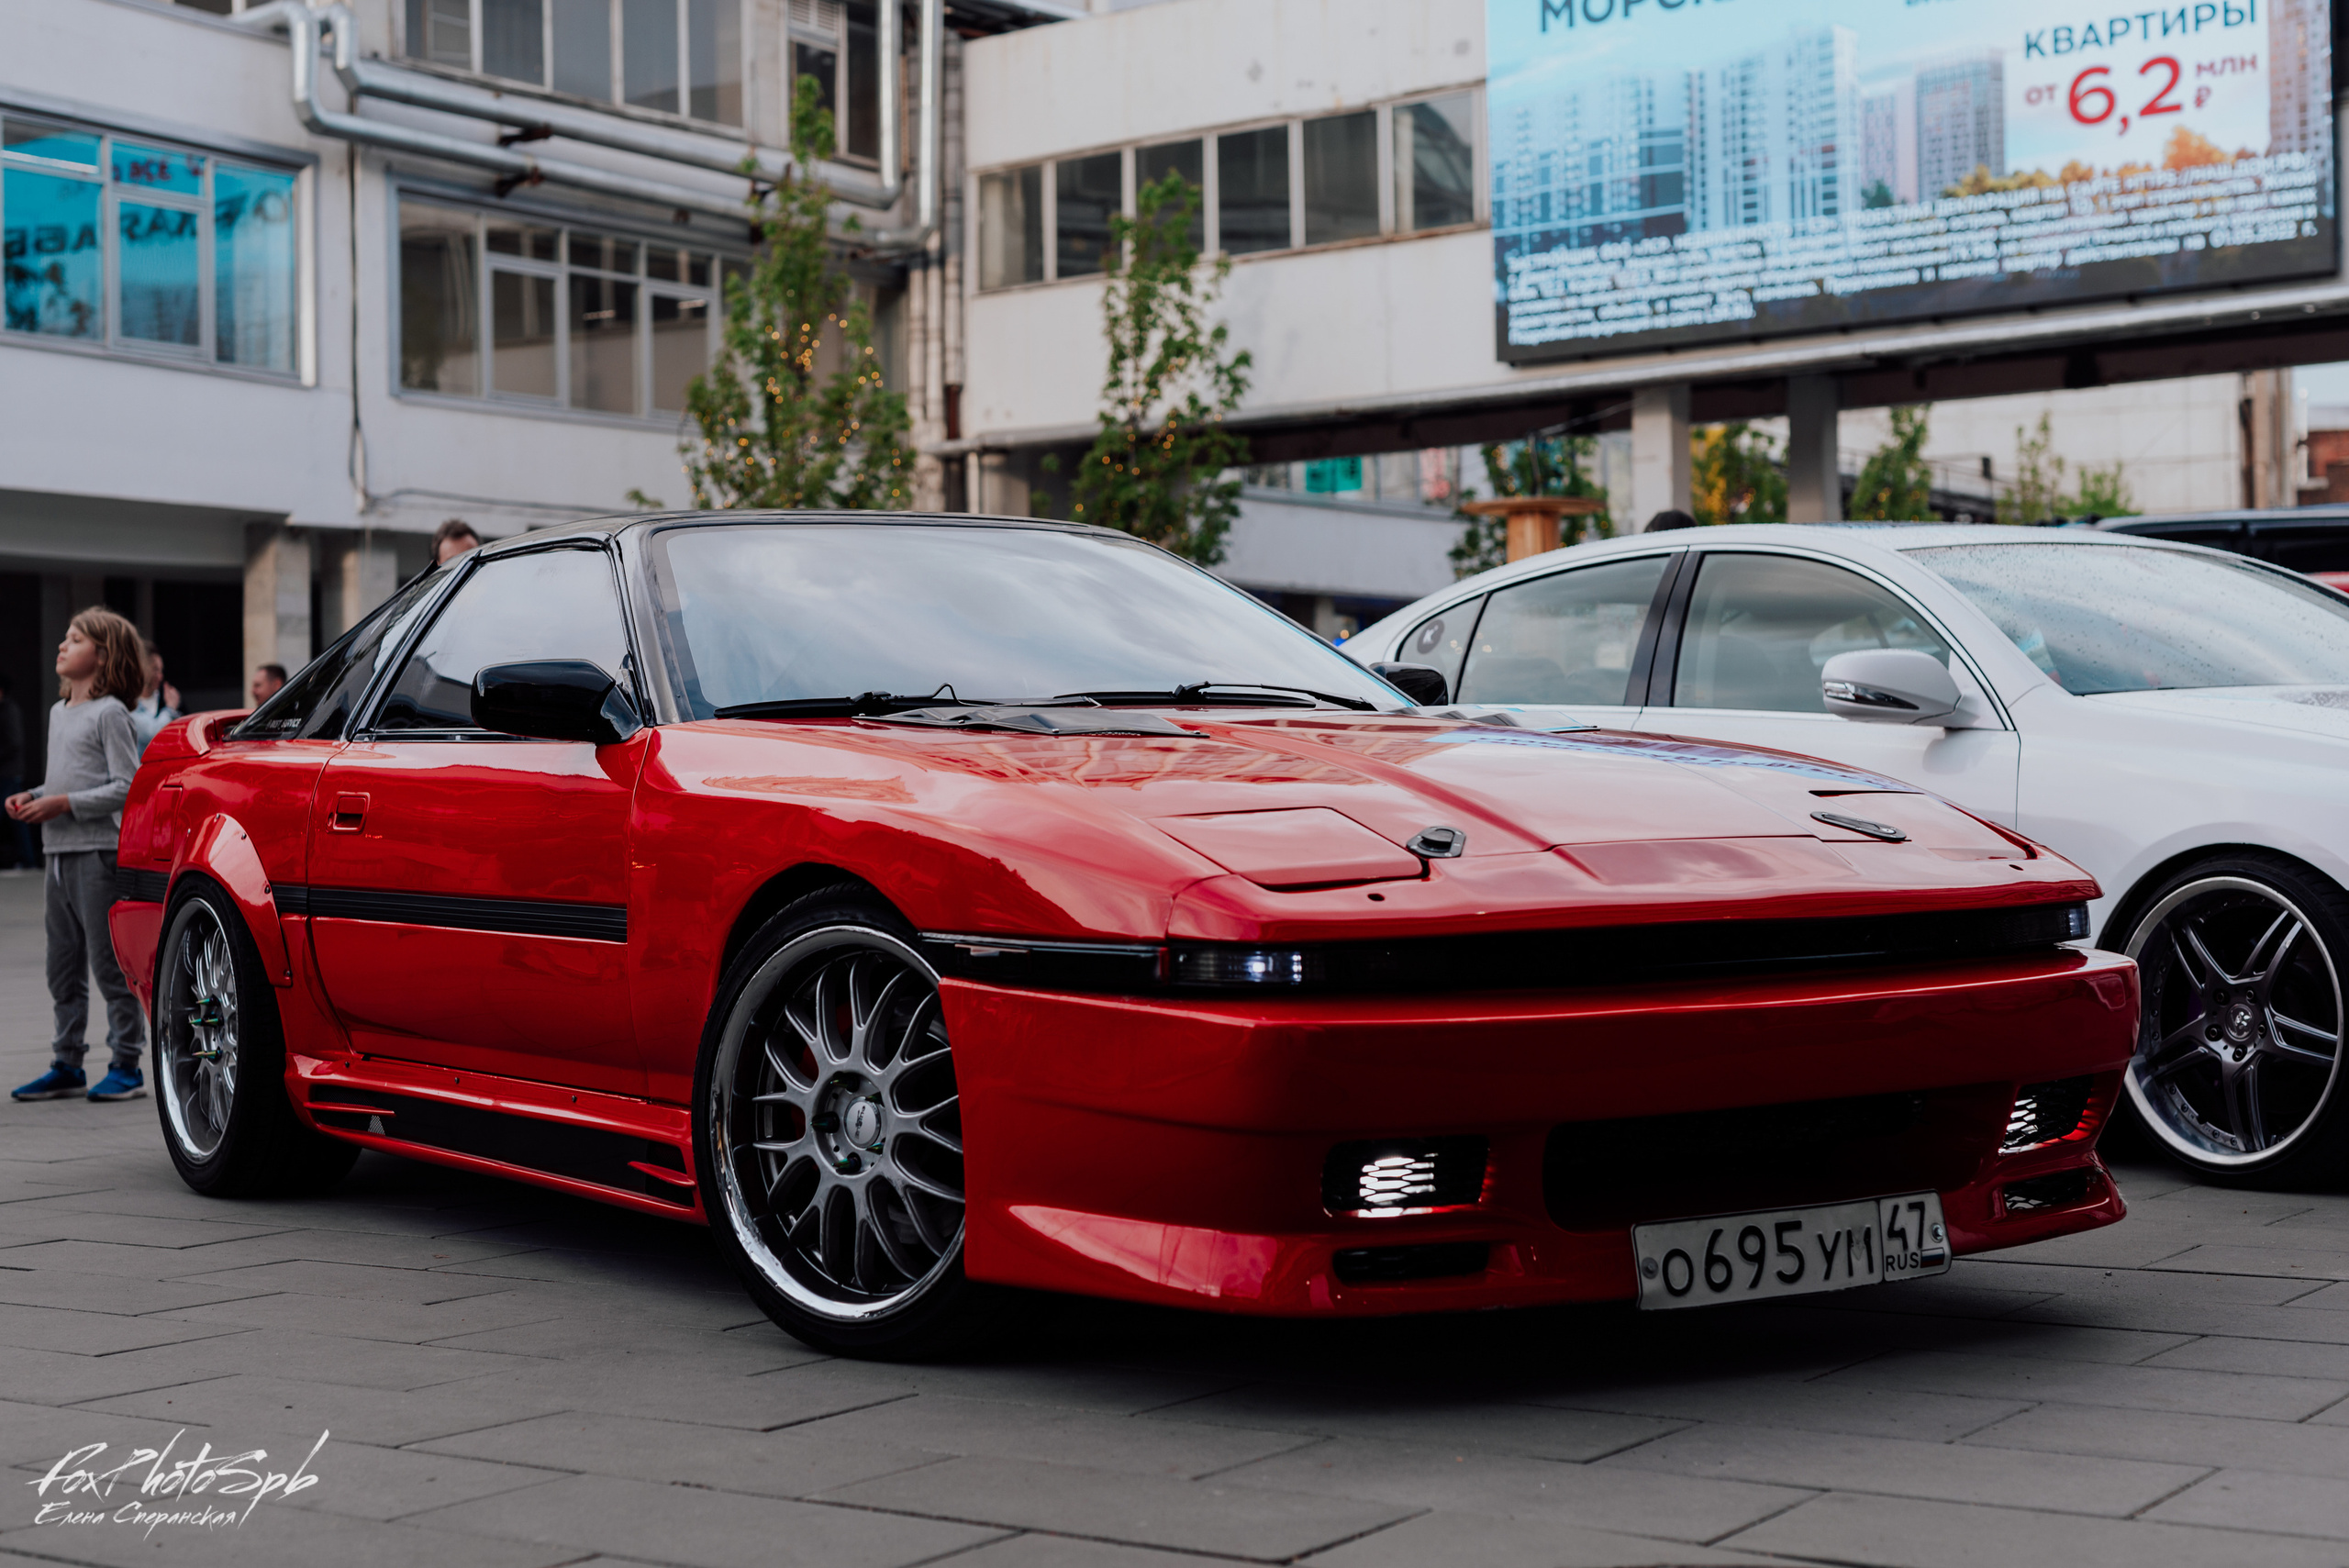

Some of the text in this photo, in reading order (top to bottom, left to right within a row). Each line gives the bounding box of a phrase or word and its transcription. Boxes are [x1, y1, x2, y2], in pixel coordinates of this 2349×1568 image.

[2024, 0, 2256, 59] КВАРТИРЫ
[2069, 56, 2181, 136] 6,2
[1886, 1200, 1926, 1253] 47
[1885, 1251, 1920, 1273] RUS
